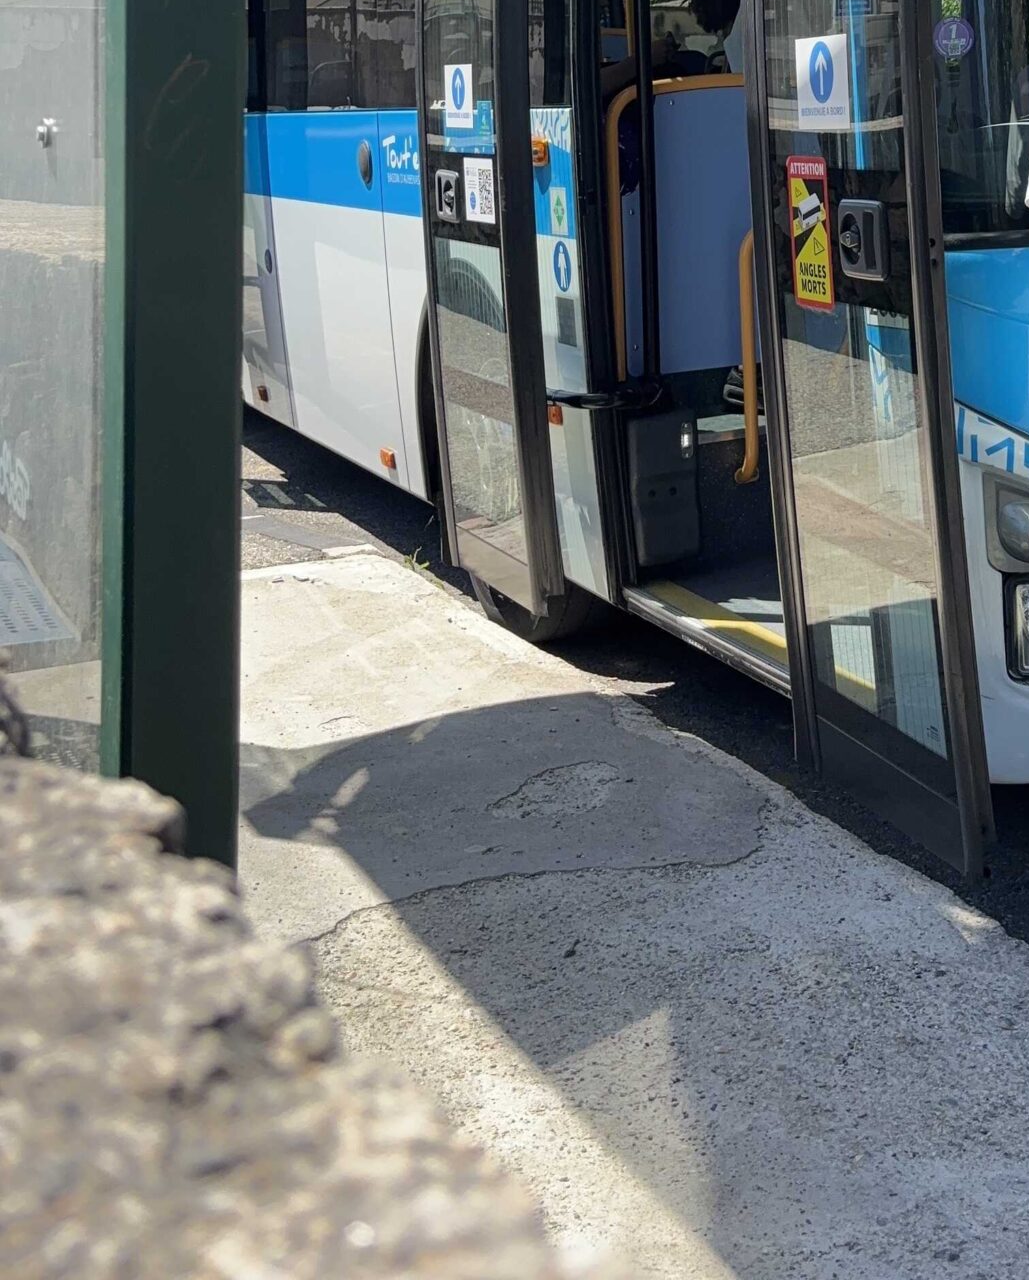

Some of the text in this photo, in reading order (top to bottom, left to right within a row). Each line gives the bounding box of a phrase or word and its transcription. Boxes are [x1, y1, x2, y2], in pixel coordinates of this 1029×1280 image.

[790, 162, 825, 176] ATTENTION
[799, 261, 827, 279] ANGLES
[801, 278, 827, 296] MORTS
